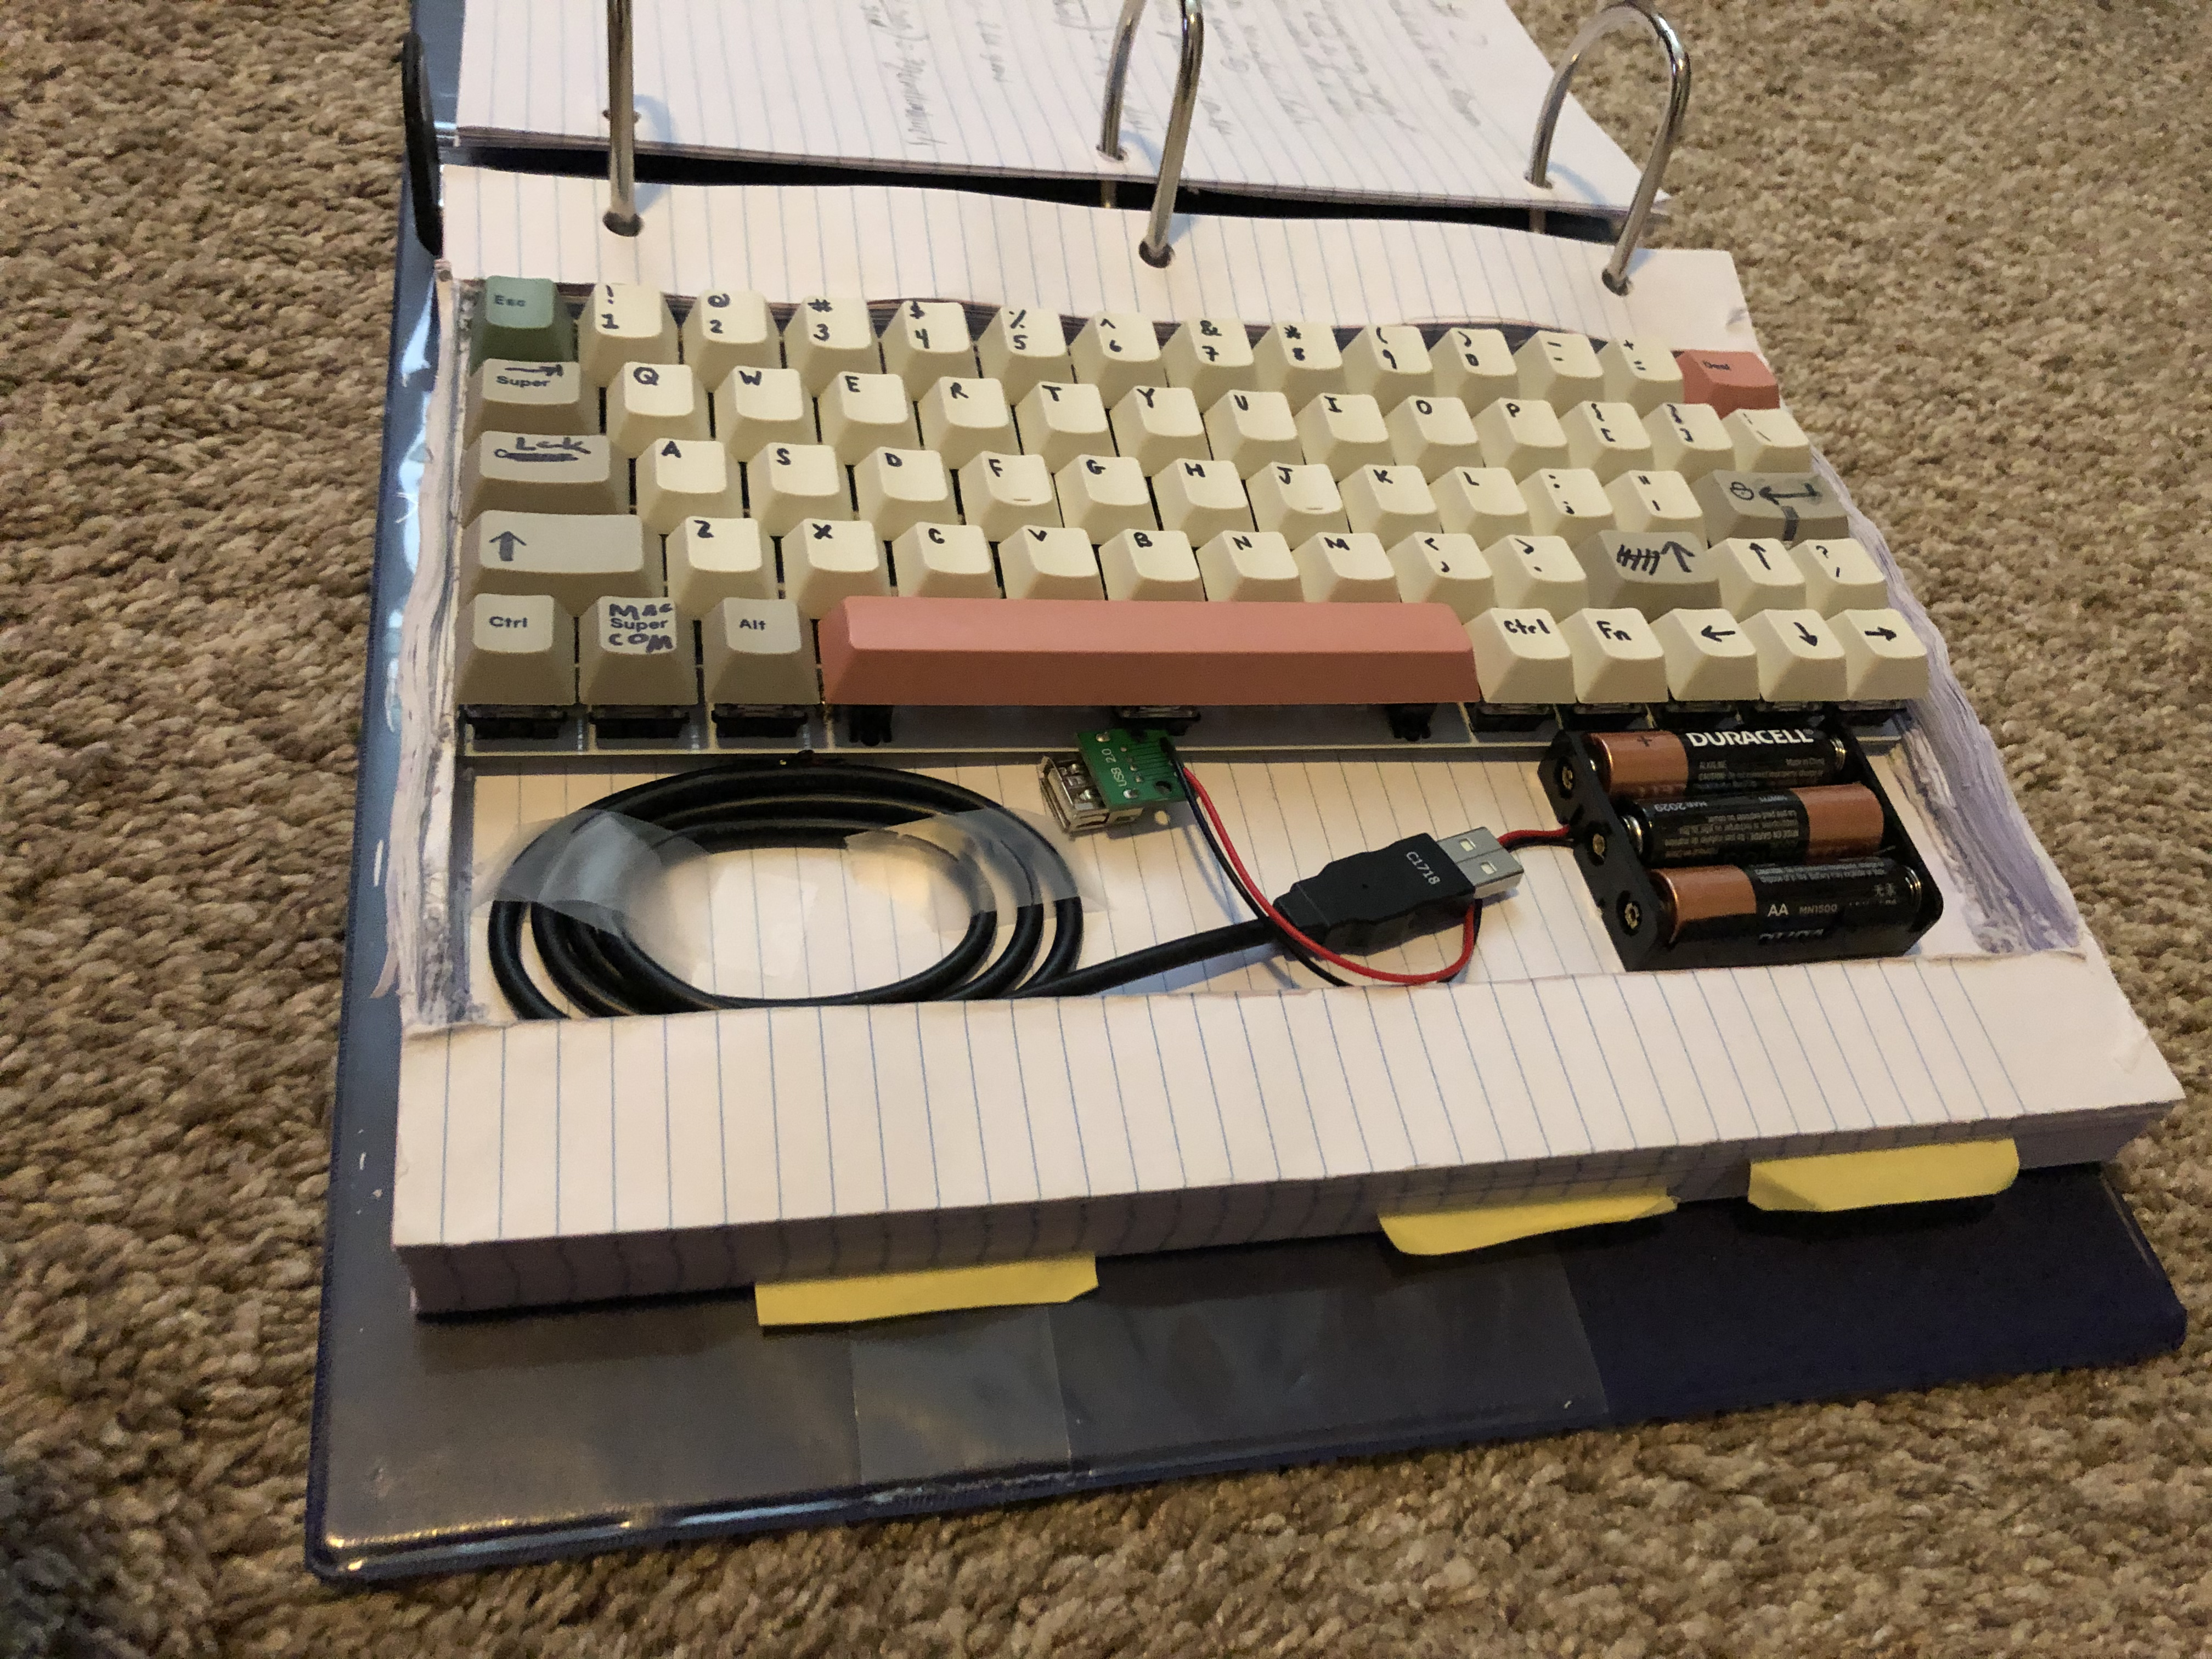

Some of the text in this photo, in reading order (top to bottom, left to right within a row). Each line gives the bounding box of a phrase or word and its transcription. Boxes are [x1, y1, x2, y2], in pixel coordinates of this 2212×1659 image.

[493, 294, 526, 307] Esc
[606, 285, 614, 304] !
[707, 293, 730, 308] @
[807, 298, 833, 313] #
[601, 313, 619, 330] 1
[709, 319, 723, 334] 2
[1199, 320, 1222, 336] &
[813, 323, 830, 342] 3
[915, 328, 930, 349] 4
[1013, 334, 1028, 351] 5
[1109, 340, 1122, 353] 6
[1623, 340, 1634, 350] +
[1201, 345, 1219, 362] 7
[1465, 353, 1479, 366] 0
[495, 375, 551, 388] Super
[633, 366, 659, 386] Q
[738, 370, 762, 386] W
[844, 375, 860, 393] E
[950, 382, 969, 399] R
[1041, 385, 1062, 402] T
[1136, 388, 1155, 409] Y
[1234, 394, 1249, 411] U
[1324, 396, 1342, 413] I
[1415, 399, 1432, 415] O
[1506, 403, 1520, 417] P
[661, 441, 681, 459] A
[776, 448, 791, 466] S
[884, 452, 902, 467] D
[1086, 459, 1106, 475] G
[988, 459, 1003, 477] F
[1184, 462, 1206, 478] H
[1277, 466, 1293, 485] J
[1373, 469, 1393, 484] K
[1463, 471, 1480, 486] L
[693, 520, 714, 539] Z
[812, 523, 833, 540] X
[928, 528, 945, 544] C
[1028, 528, 1047, 542] V
[1133, 532, 1153, 548] B
[1232, 535, 1252, 551] N
[1324, 537, 1350, 551] M
[489, 616, 528, 628] Ctrl
[610, 617, 669, 633] Super
[739, 619, 766, 630] Alt
[1503, 618, 1550, 635] Ctrl
[1596, 620, 1632, 641] Fn
[1685, 729, 1814, 747] DURACELL
[1110, 766, 1127, 787] USB
[1654, 802, 1687, 812] 2029
[1406, 851, 1441, 885] C1718
[1767, 903, 1838, 917] AA MN1500
